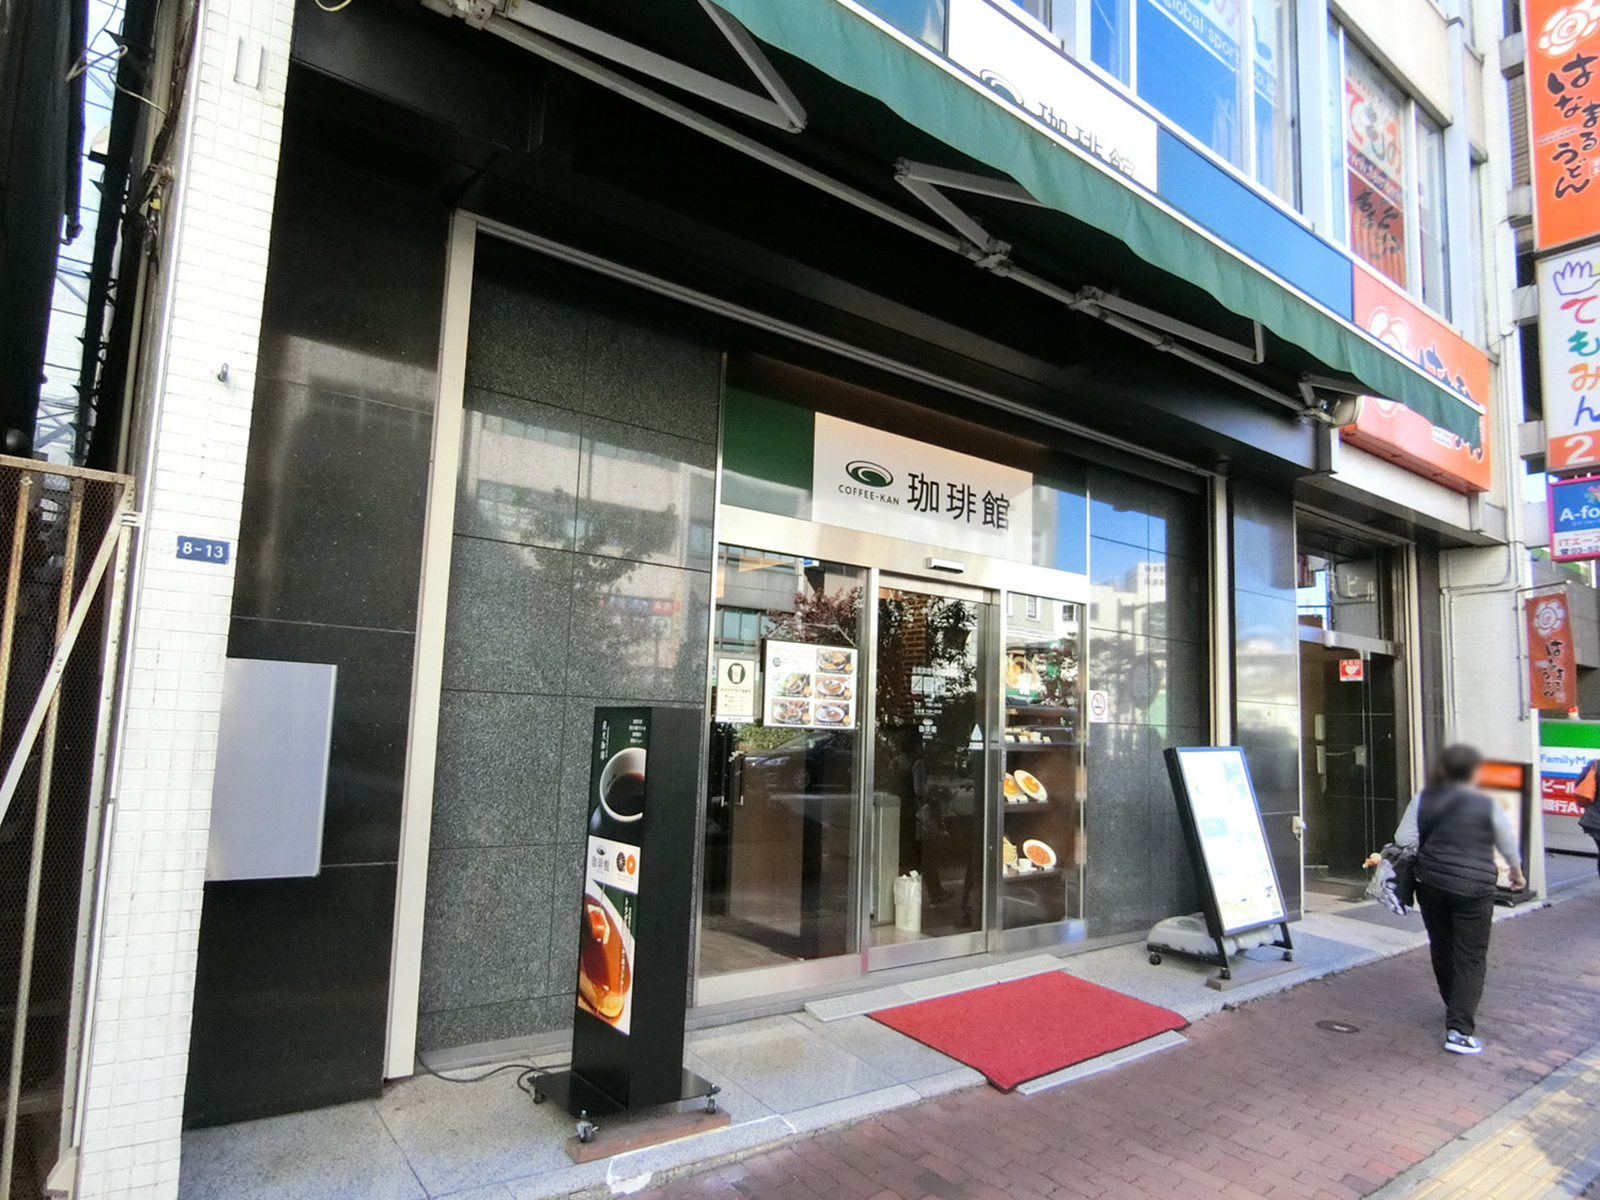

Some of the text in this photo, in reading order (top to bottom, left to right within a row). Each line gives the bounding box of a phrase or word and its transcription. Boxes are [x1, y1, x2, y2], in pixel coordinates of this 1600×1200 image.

[838, 484, 900, 506] COFFEE-KAN
[907, 472, 1010, 532] 珈琲館
[182, 541, 224, 559] 8-13
[1540, 753, 1591, 767] FamilyM
